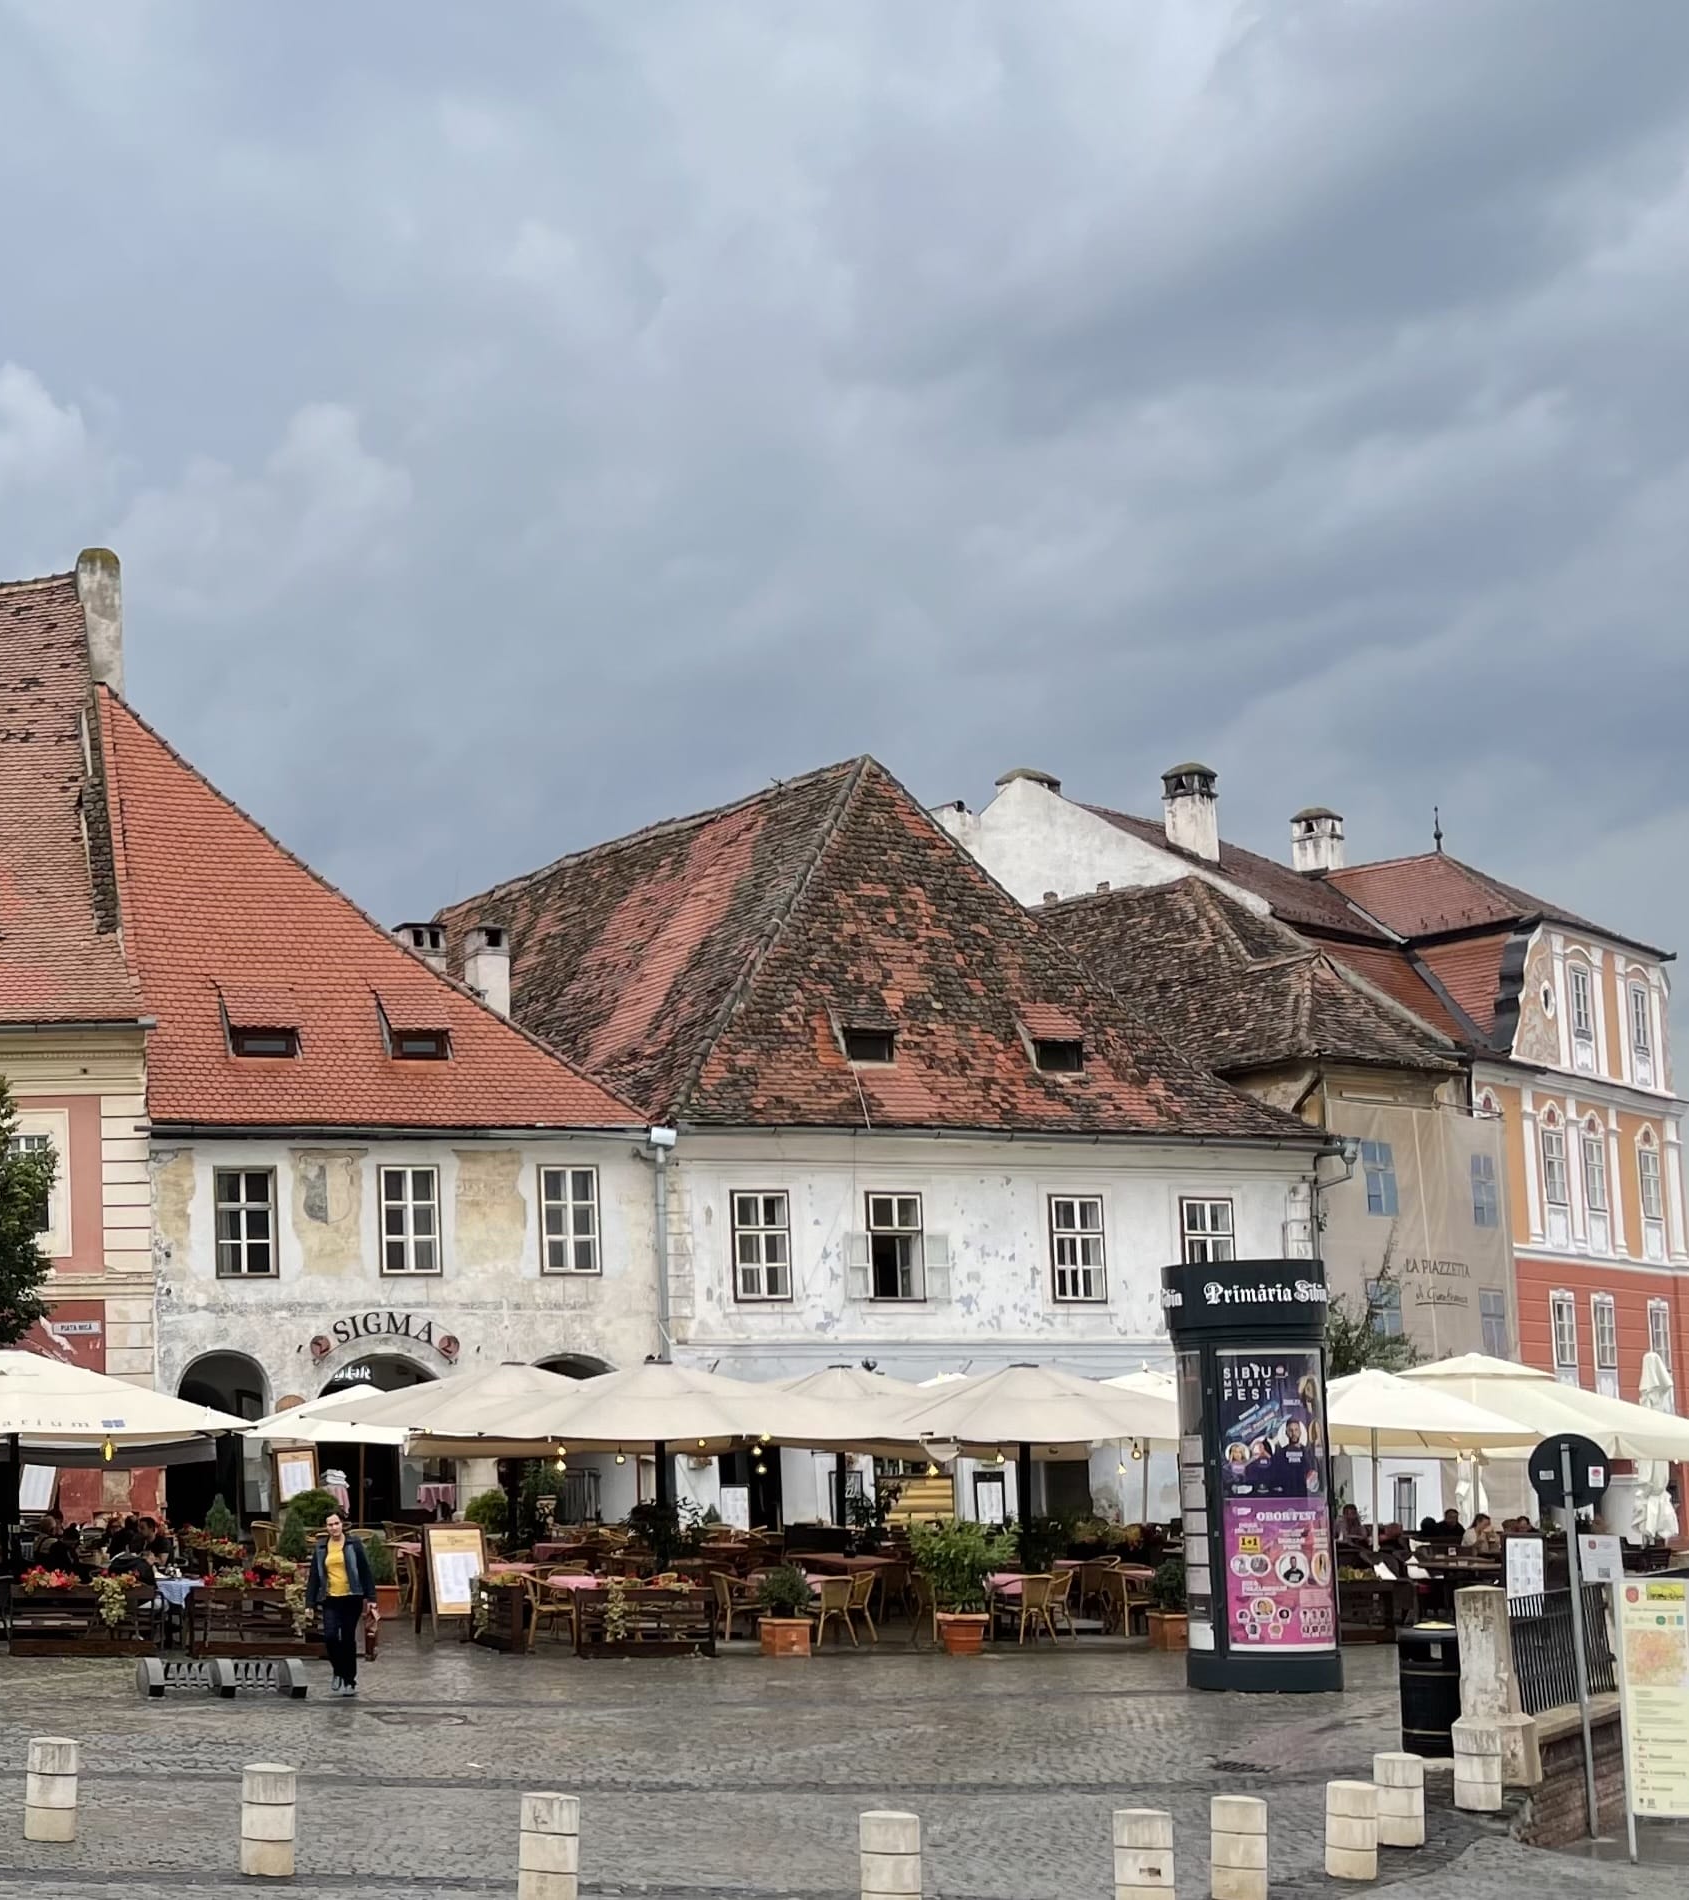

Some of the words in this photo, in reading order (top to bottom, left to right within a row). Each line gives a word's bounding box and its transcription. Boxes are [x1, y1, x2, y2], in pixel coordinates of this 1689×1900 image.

[1405, 1258, 1420, 1273] LA
[1421, 1259, 1471, 1279] PIAZZETTA
[332, 1311, 434, 1347] SIGMA
[1224, 1388, 1272, 1401] FEST
